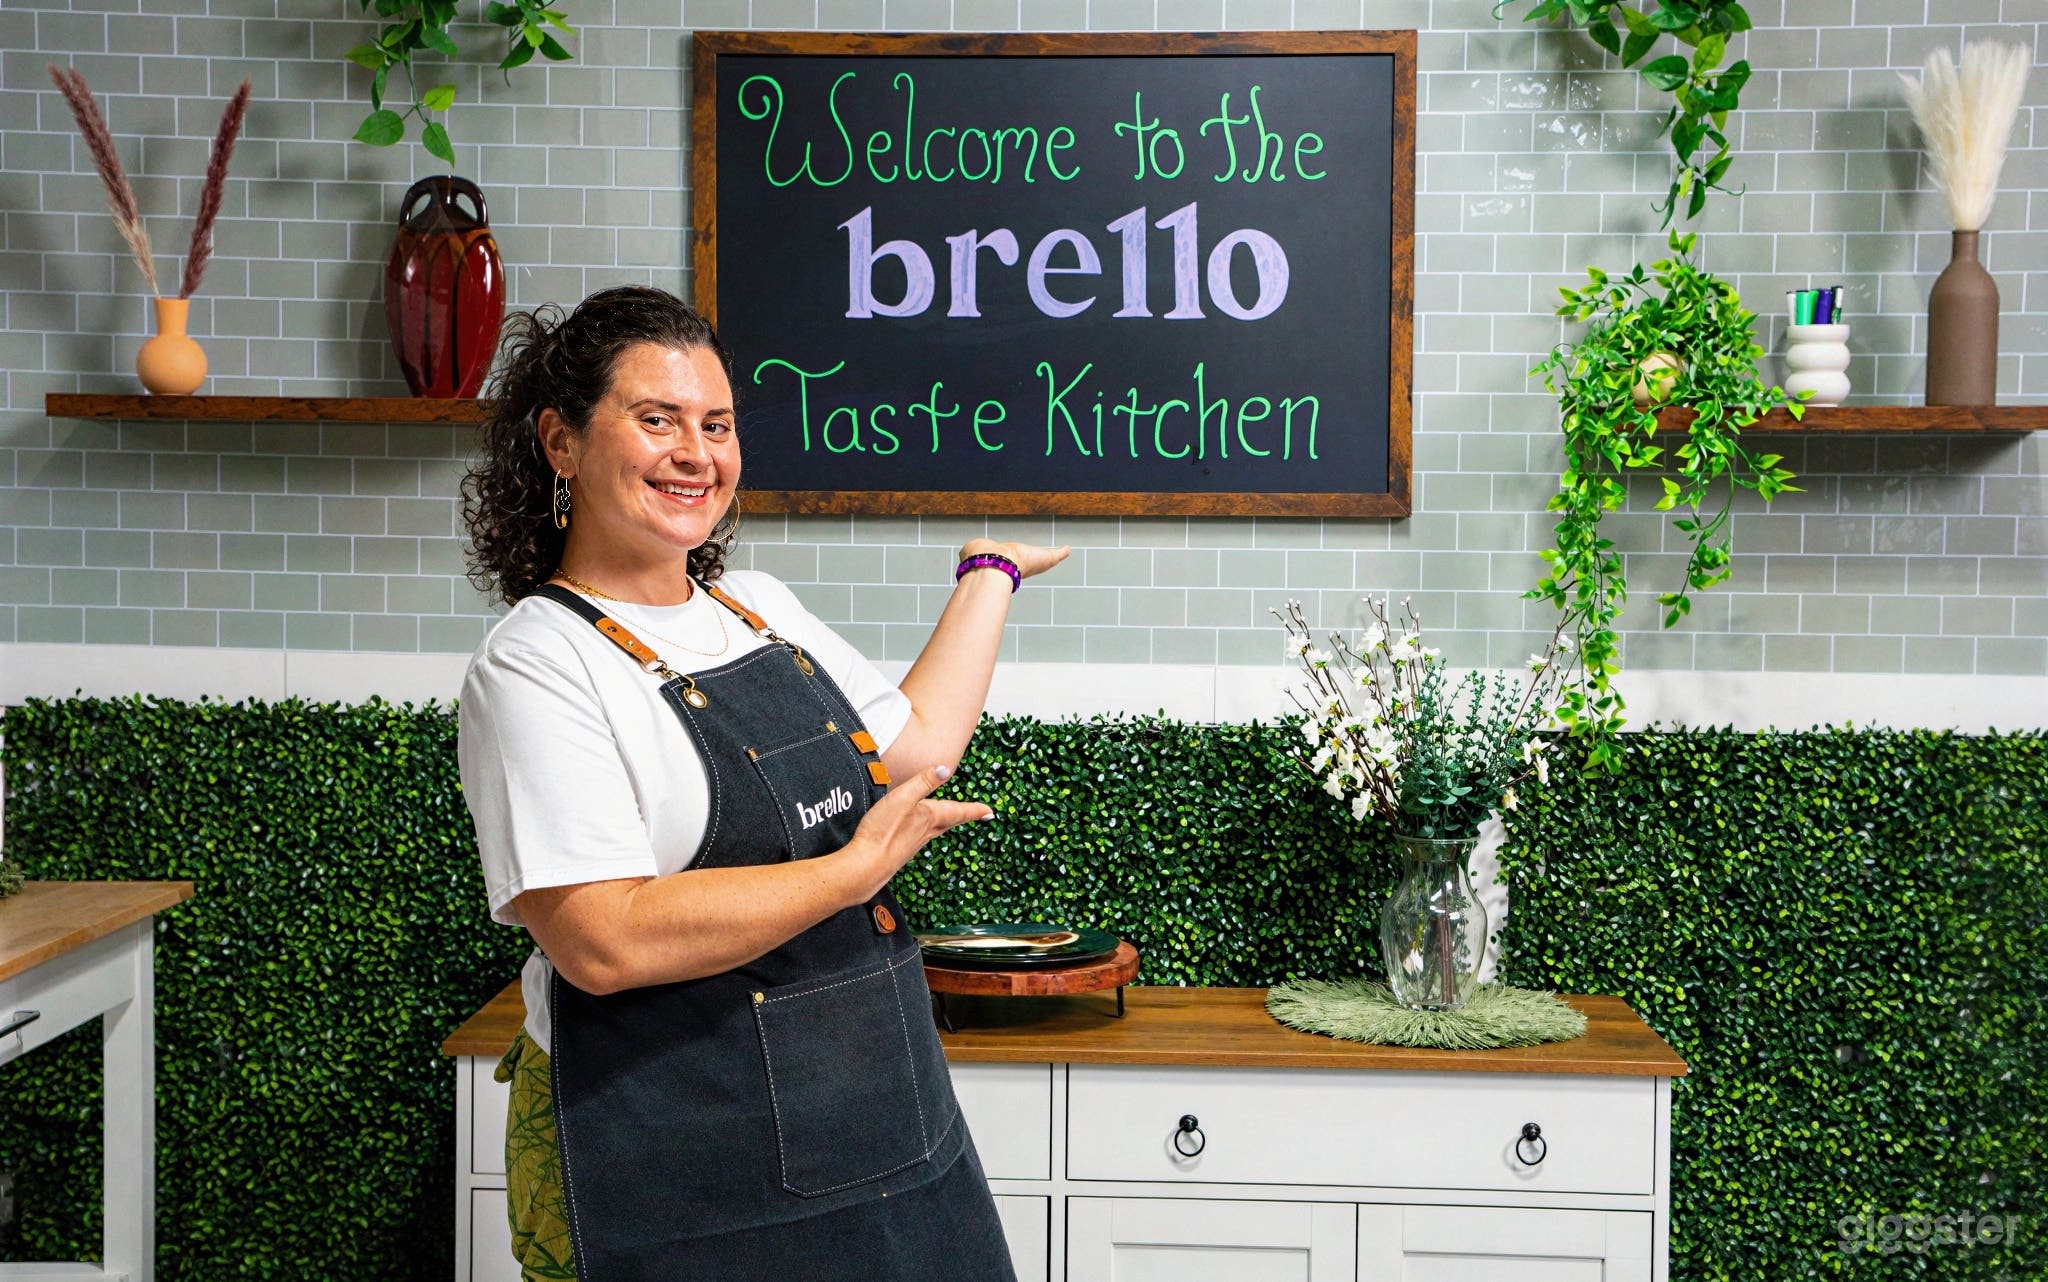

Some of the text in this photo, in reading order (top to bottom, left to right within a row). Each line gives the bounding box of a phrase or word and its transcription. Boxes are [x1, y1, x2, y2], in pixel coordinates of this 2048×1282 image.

[738, 72, 1328, 188] Welcome to the
[837, 201, 1291, 320] brello
[753, 358, 1321, 460] Taste Kitchen
[796, 786, 853, 830] brello
